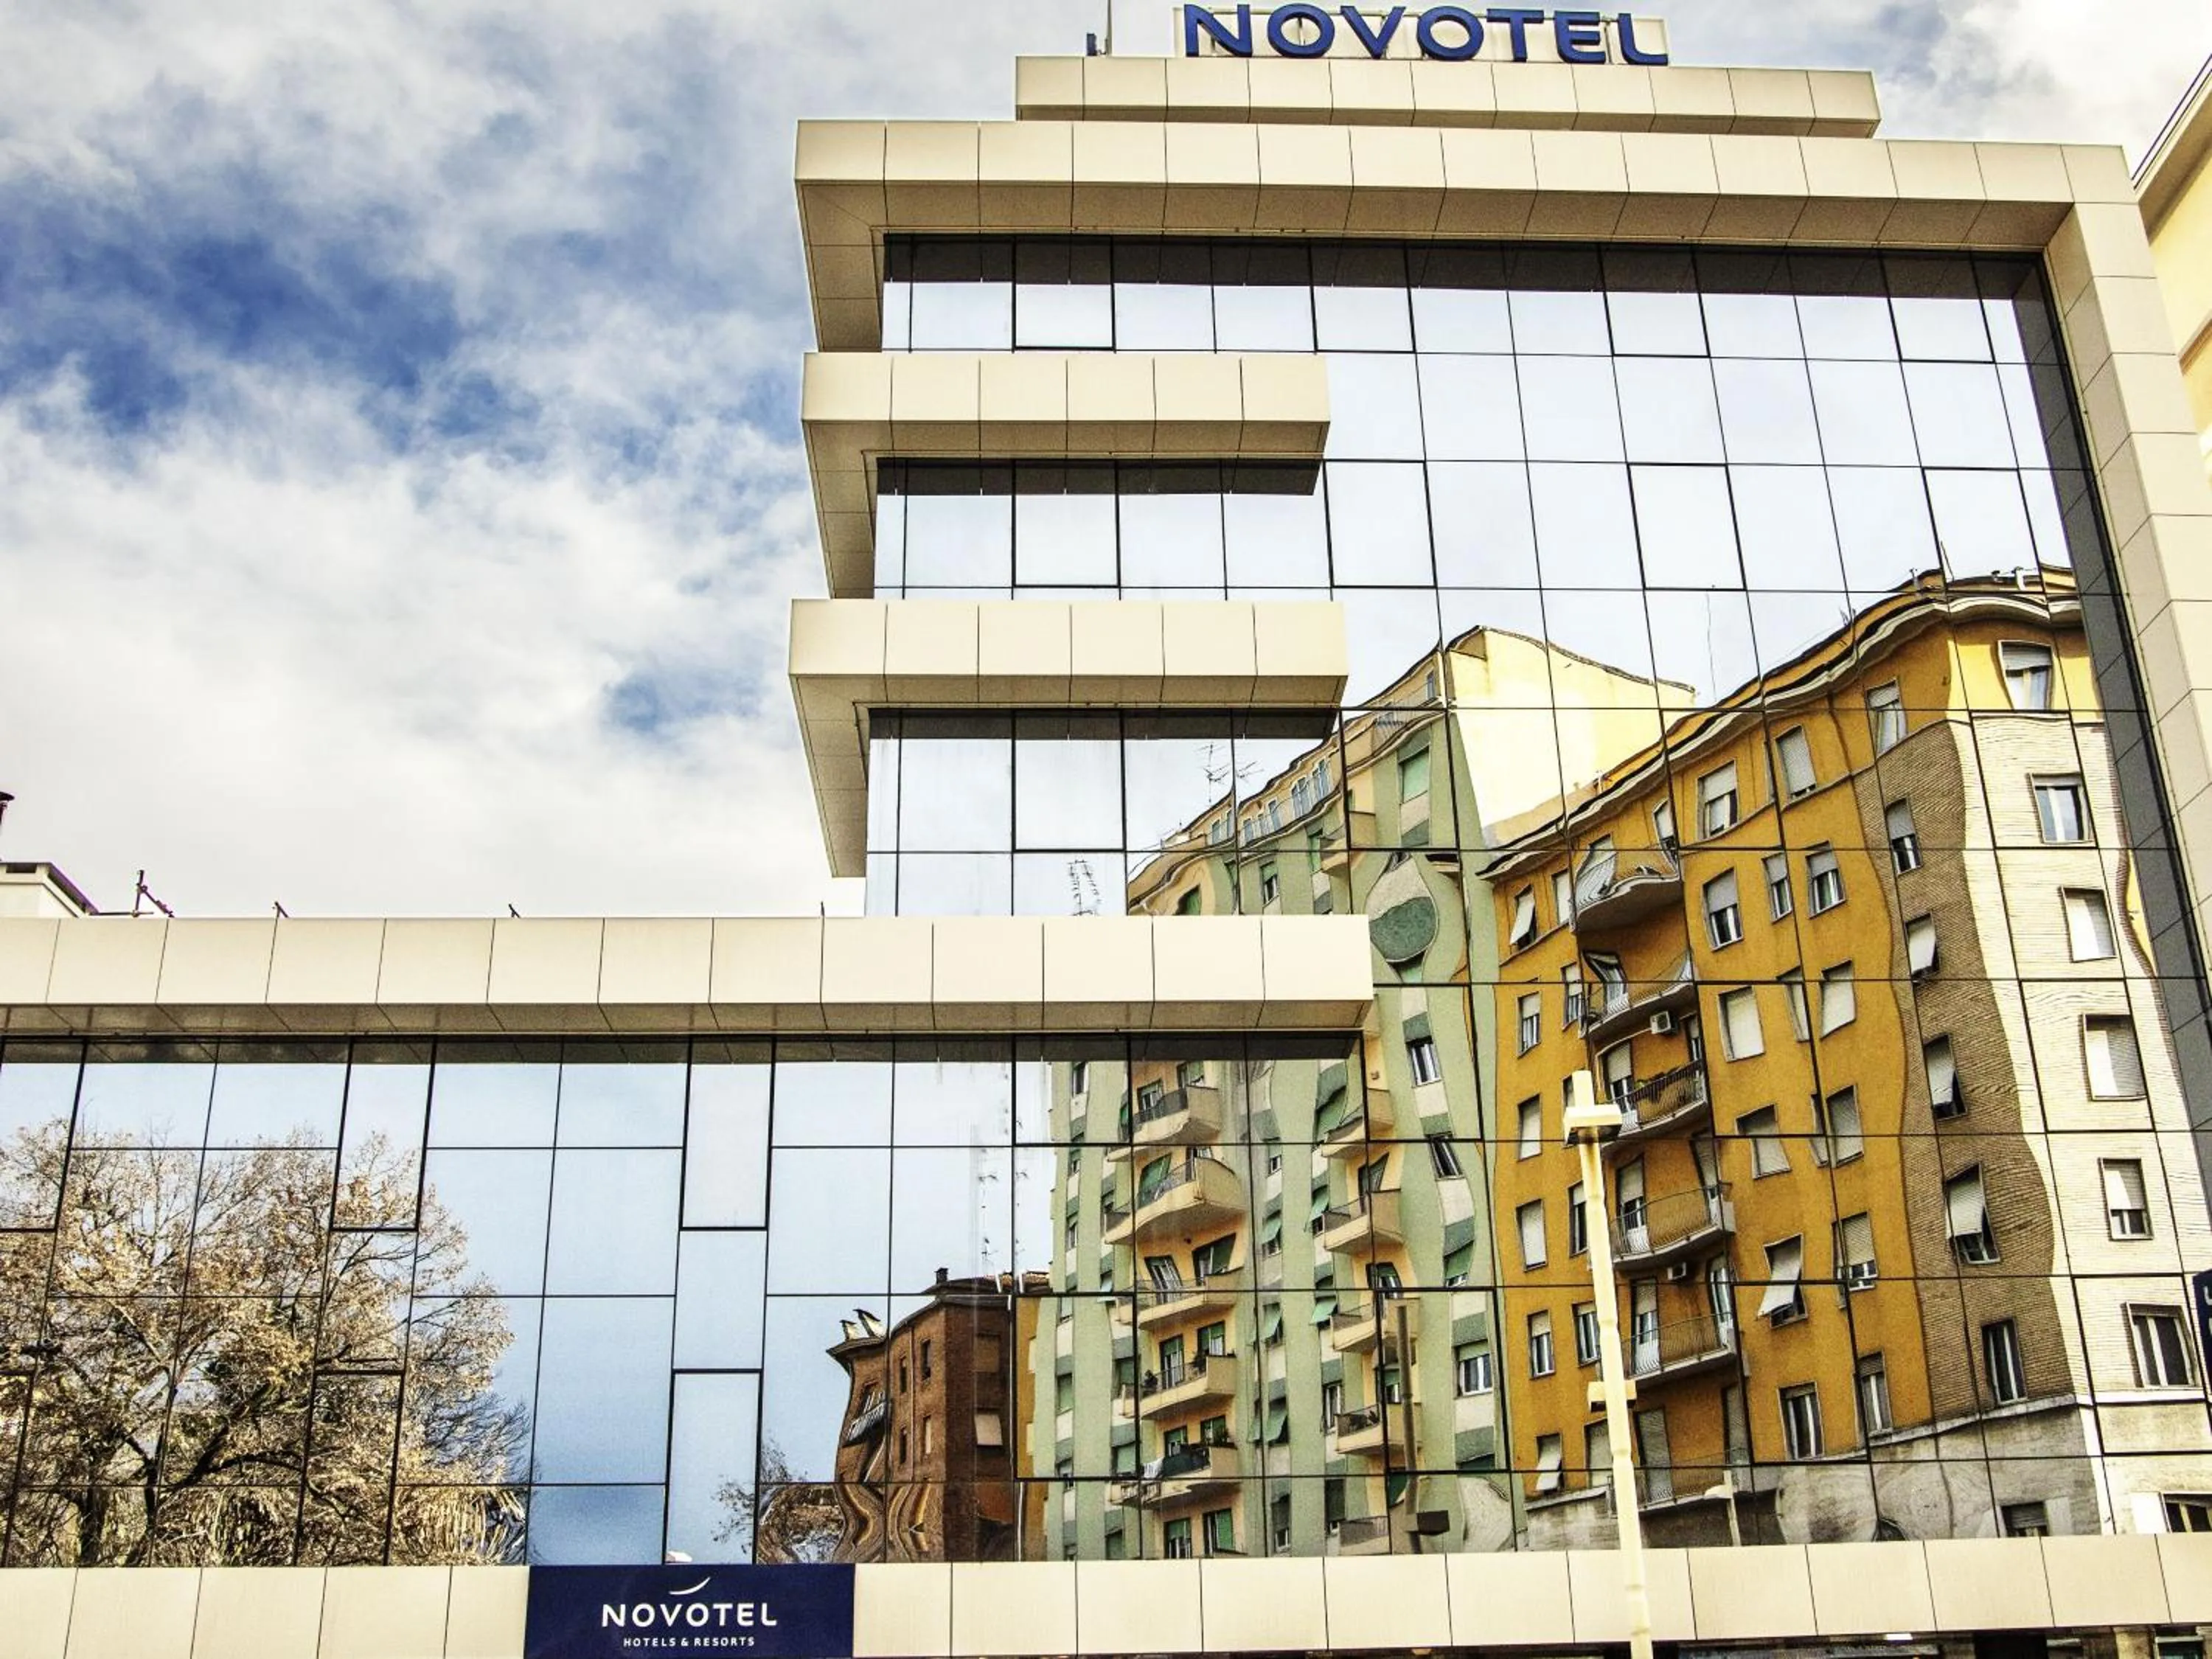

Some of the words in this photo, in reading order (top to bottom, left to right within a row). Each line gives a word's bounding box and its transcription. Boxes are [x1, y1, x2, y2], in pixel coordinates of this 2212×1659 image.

[1184, 4, 1668, 65] NOVOTEL
[601, 1602, 778, 1628] NOVOTEL
[623, 1637, 676, 1648] HOTELS
[681, 1637, 689, 1647] &
[694, 1636, 755, 1647] RESORTS
